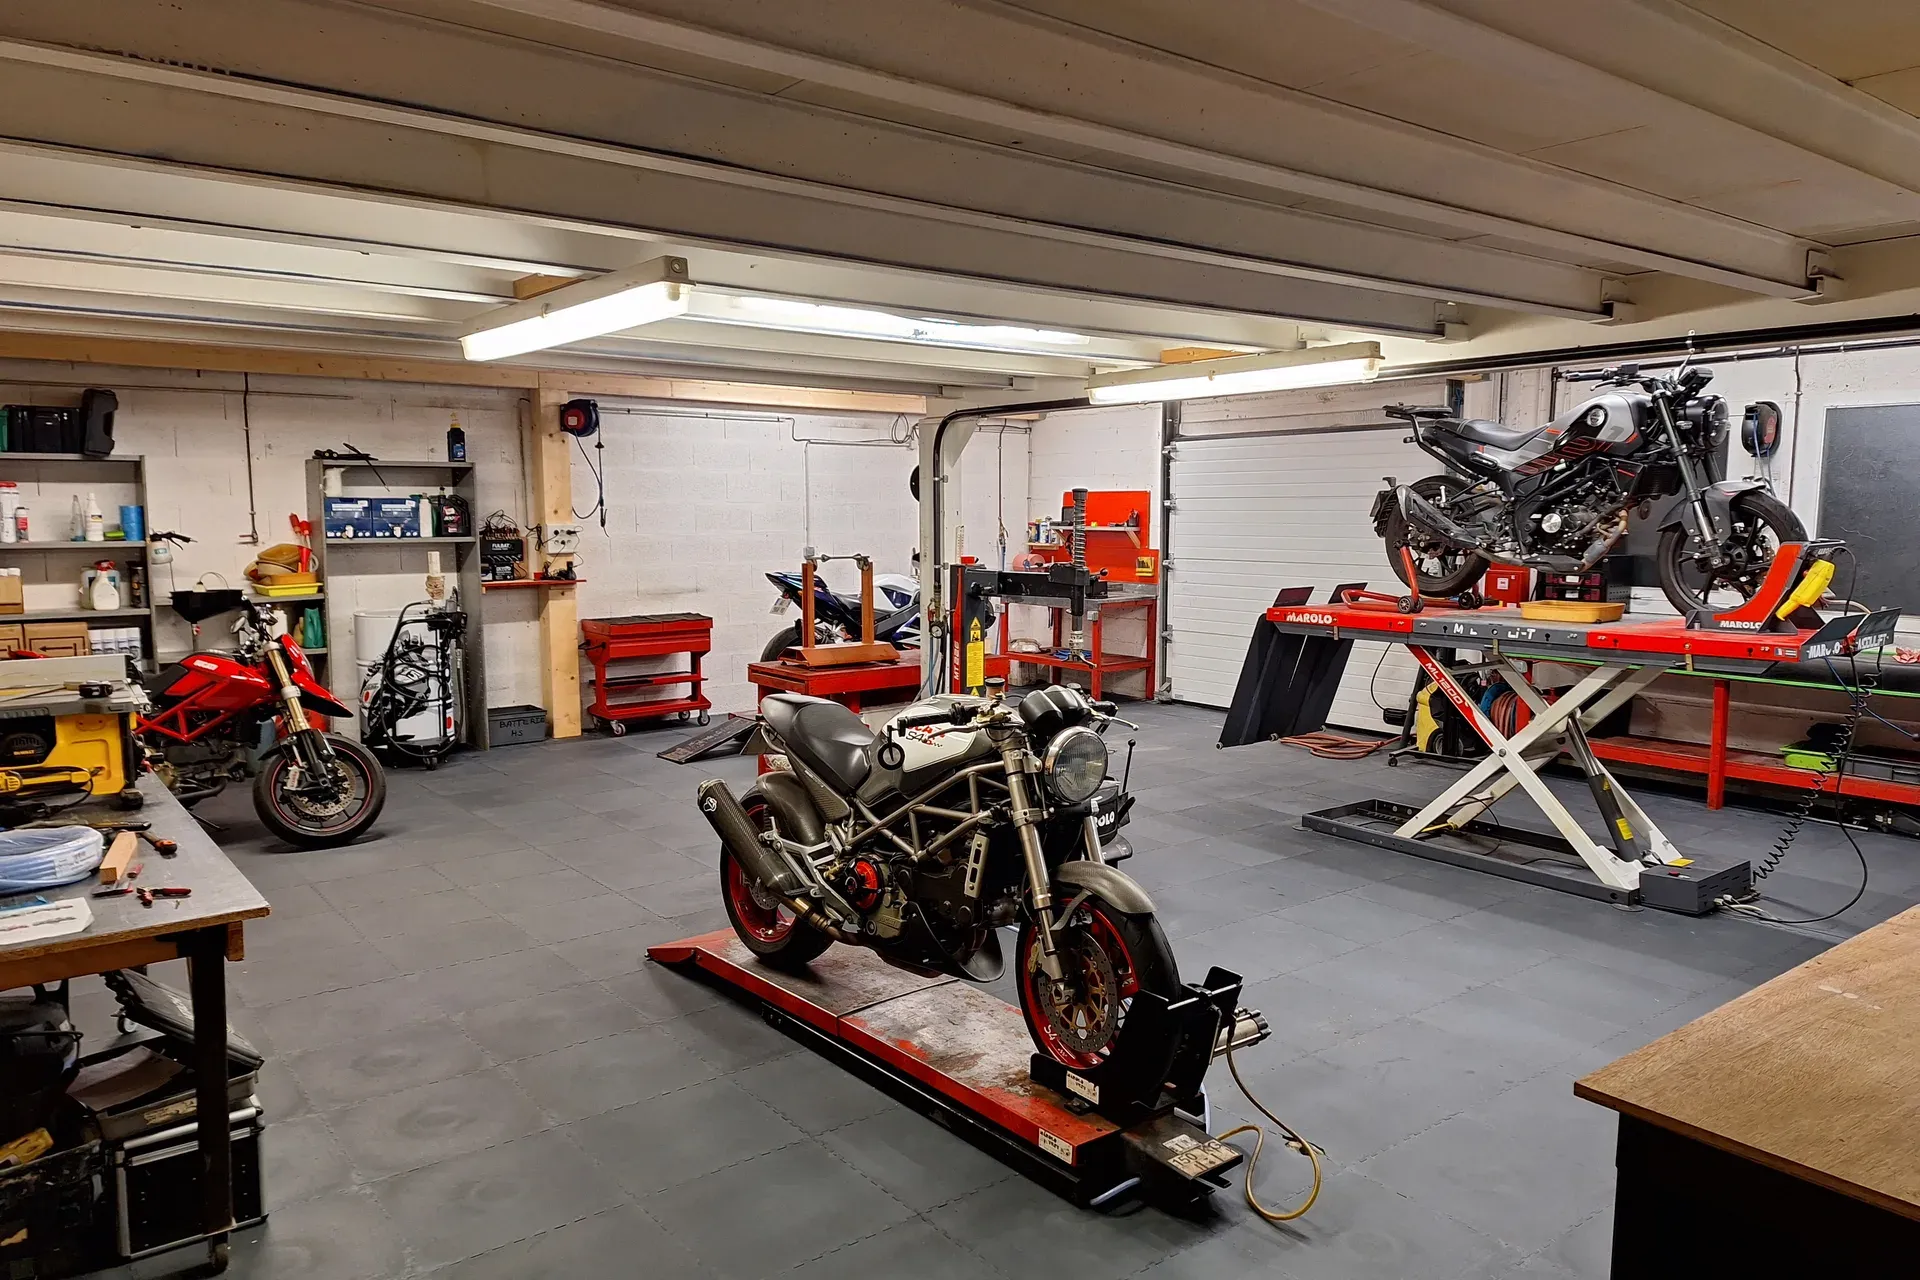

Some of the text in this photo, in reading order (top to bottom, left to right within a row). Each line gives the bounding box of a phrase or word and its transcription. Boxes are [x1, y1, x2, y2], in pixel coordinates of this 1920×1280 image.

[1286, 611, 1333, 625] MAROLO
[1720, 620, 1763, 629] MAROLO
[1808, 641, 1841, 659] MARO
[1172, 1152, 1199, 1167] 150
